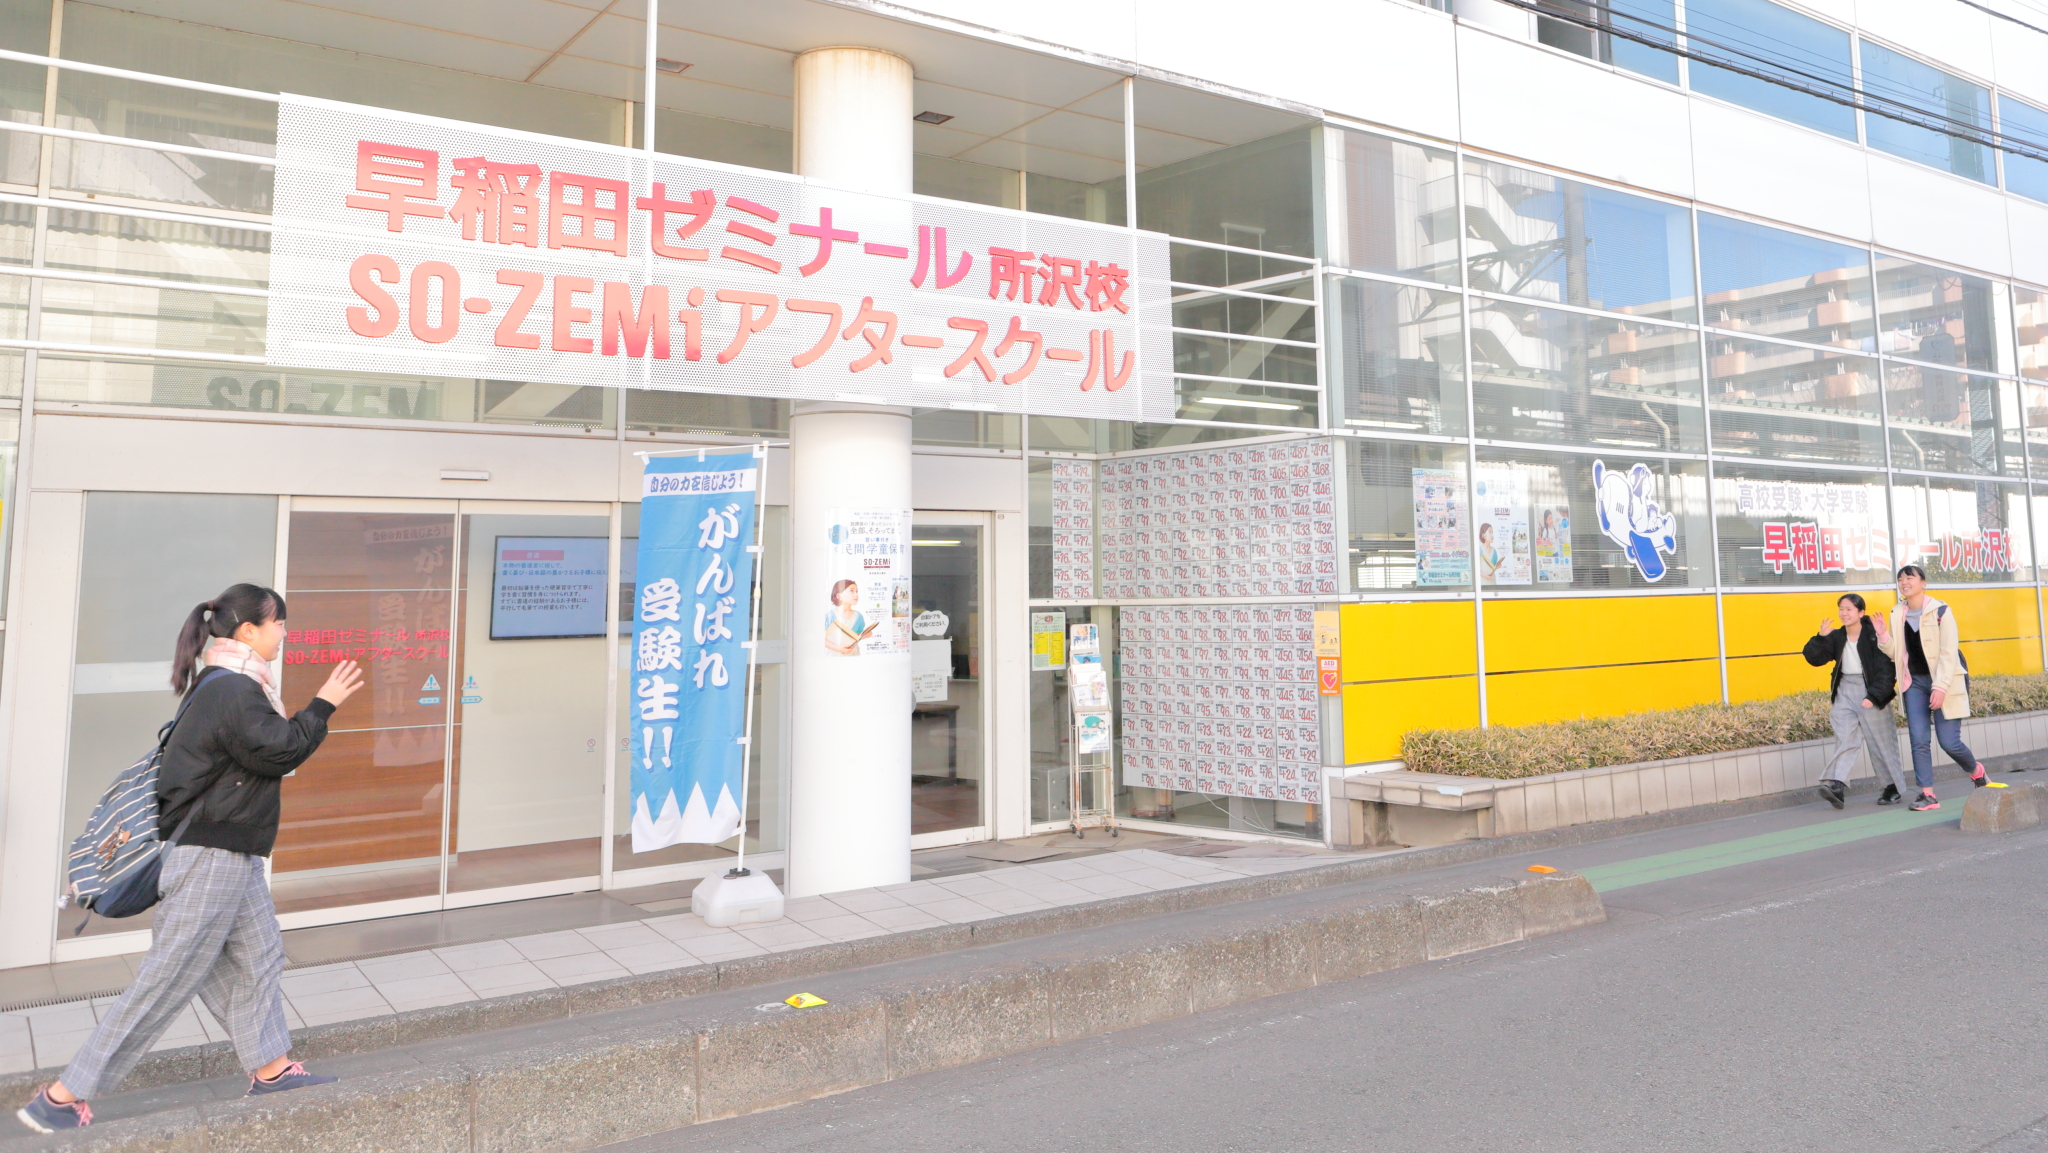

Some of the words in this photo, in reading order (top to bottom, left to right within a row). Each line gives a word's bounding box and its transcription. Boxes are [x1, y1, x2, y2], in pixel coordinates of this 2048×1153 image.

[346, 140, 973, 289] 早稲田ゼミナール
[988, 246, 1130, 314] 所沢校
[1738, 484, 1869, 514] 高校受験・大学受験
[287, 628, 411, 645] 早稲田ゼミナール
[694, 502, 741, 690] がんばれ
